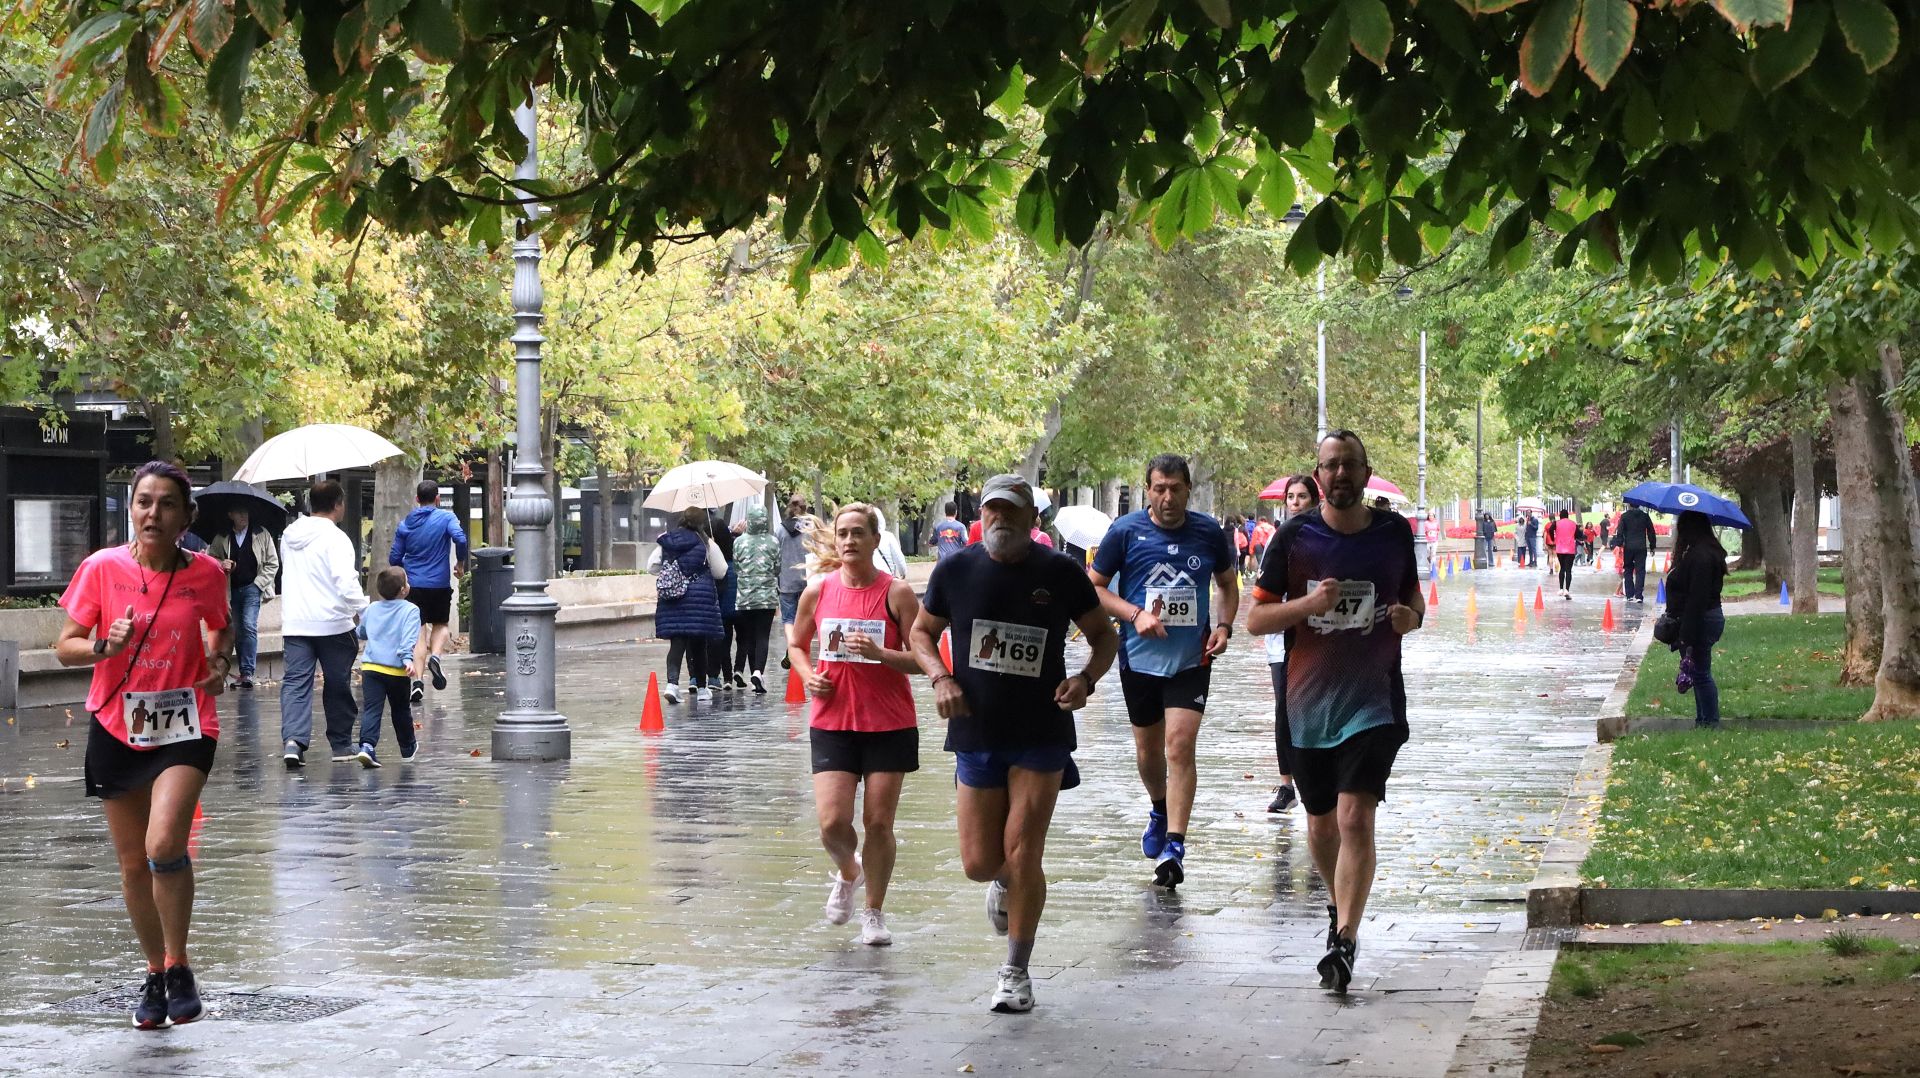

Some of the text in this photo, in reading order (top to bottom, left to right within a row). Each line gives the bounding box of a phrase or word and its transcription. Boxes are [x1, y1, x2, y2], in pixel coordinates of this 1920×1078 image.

[1168, 602, 1189, 616] 89
[1335, 598, 1363, 615] 47
[131, 612, 153, 623] WE
[999, 641, 1039, 663] 169
[150, 708, 190, 731] 171
